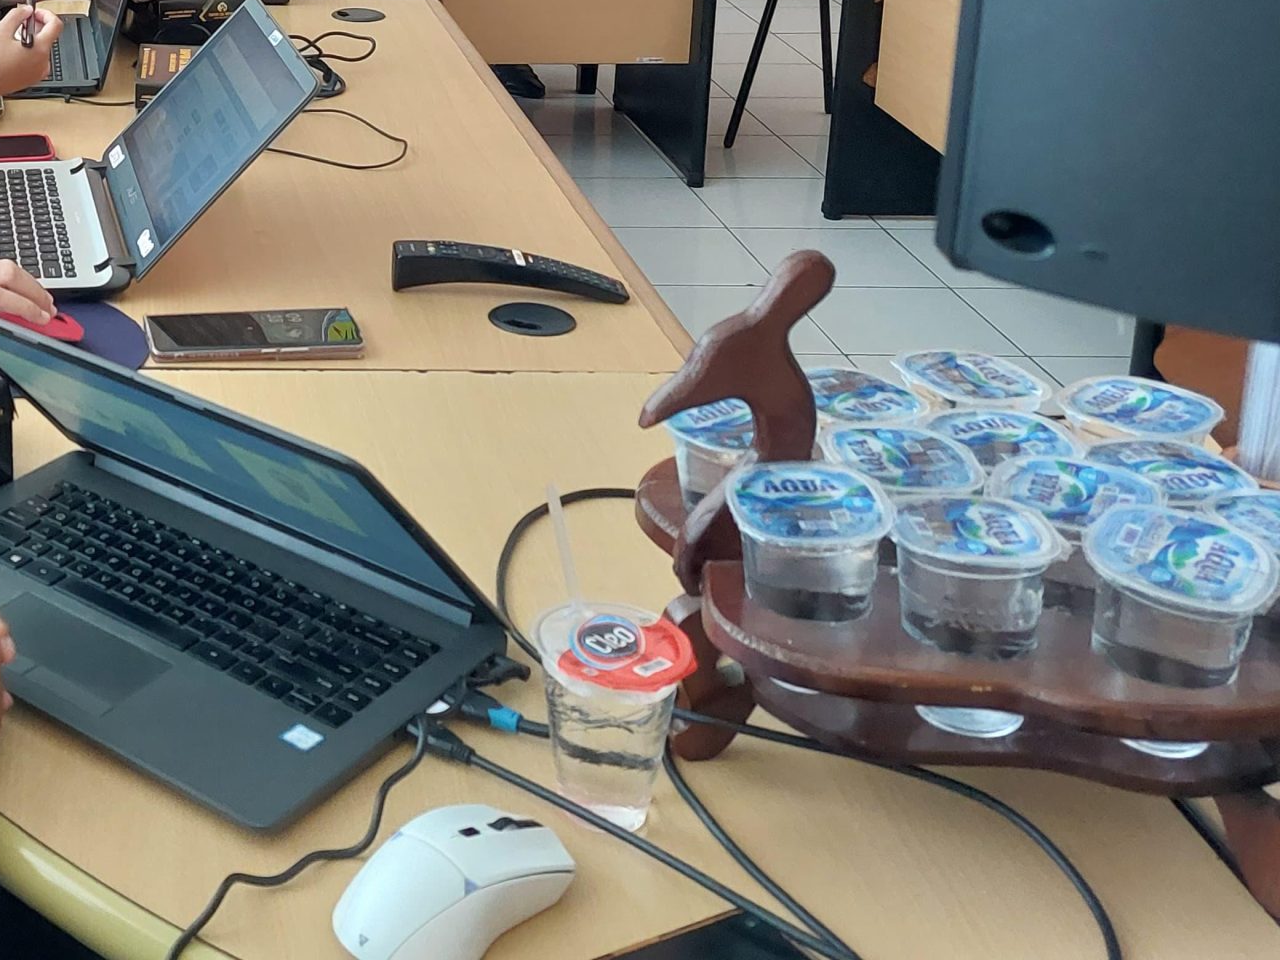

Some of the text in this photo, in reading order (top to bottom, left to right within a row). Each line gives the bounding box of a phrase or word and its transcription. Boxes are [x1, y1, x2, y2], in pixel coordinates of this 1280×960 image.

[686, 401, 743, 426] AQUA
[951, 416, 1017, 437] AQUA
[763, 478, 839, 494] AQUA
